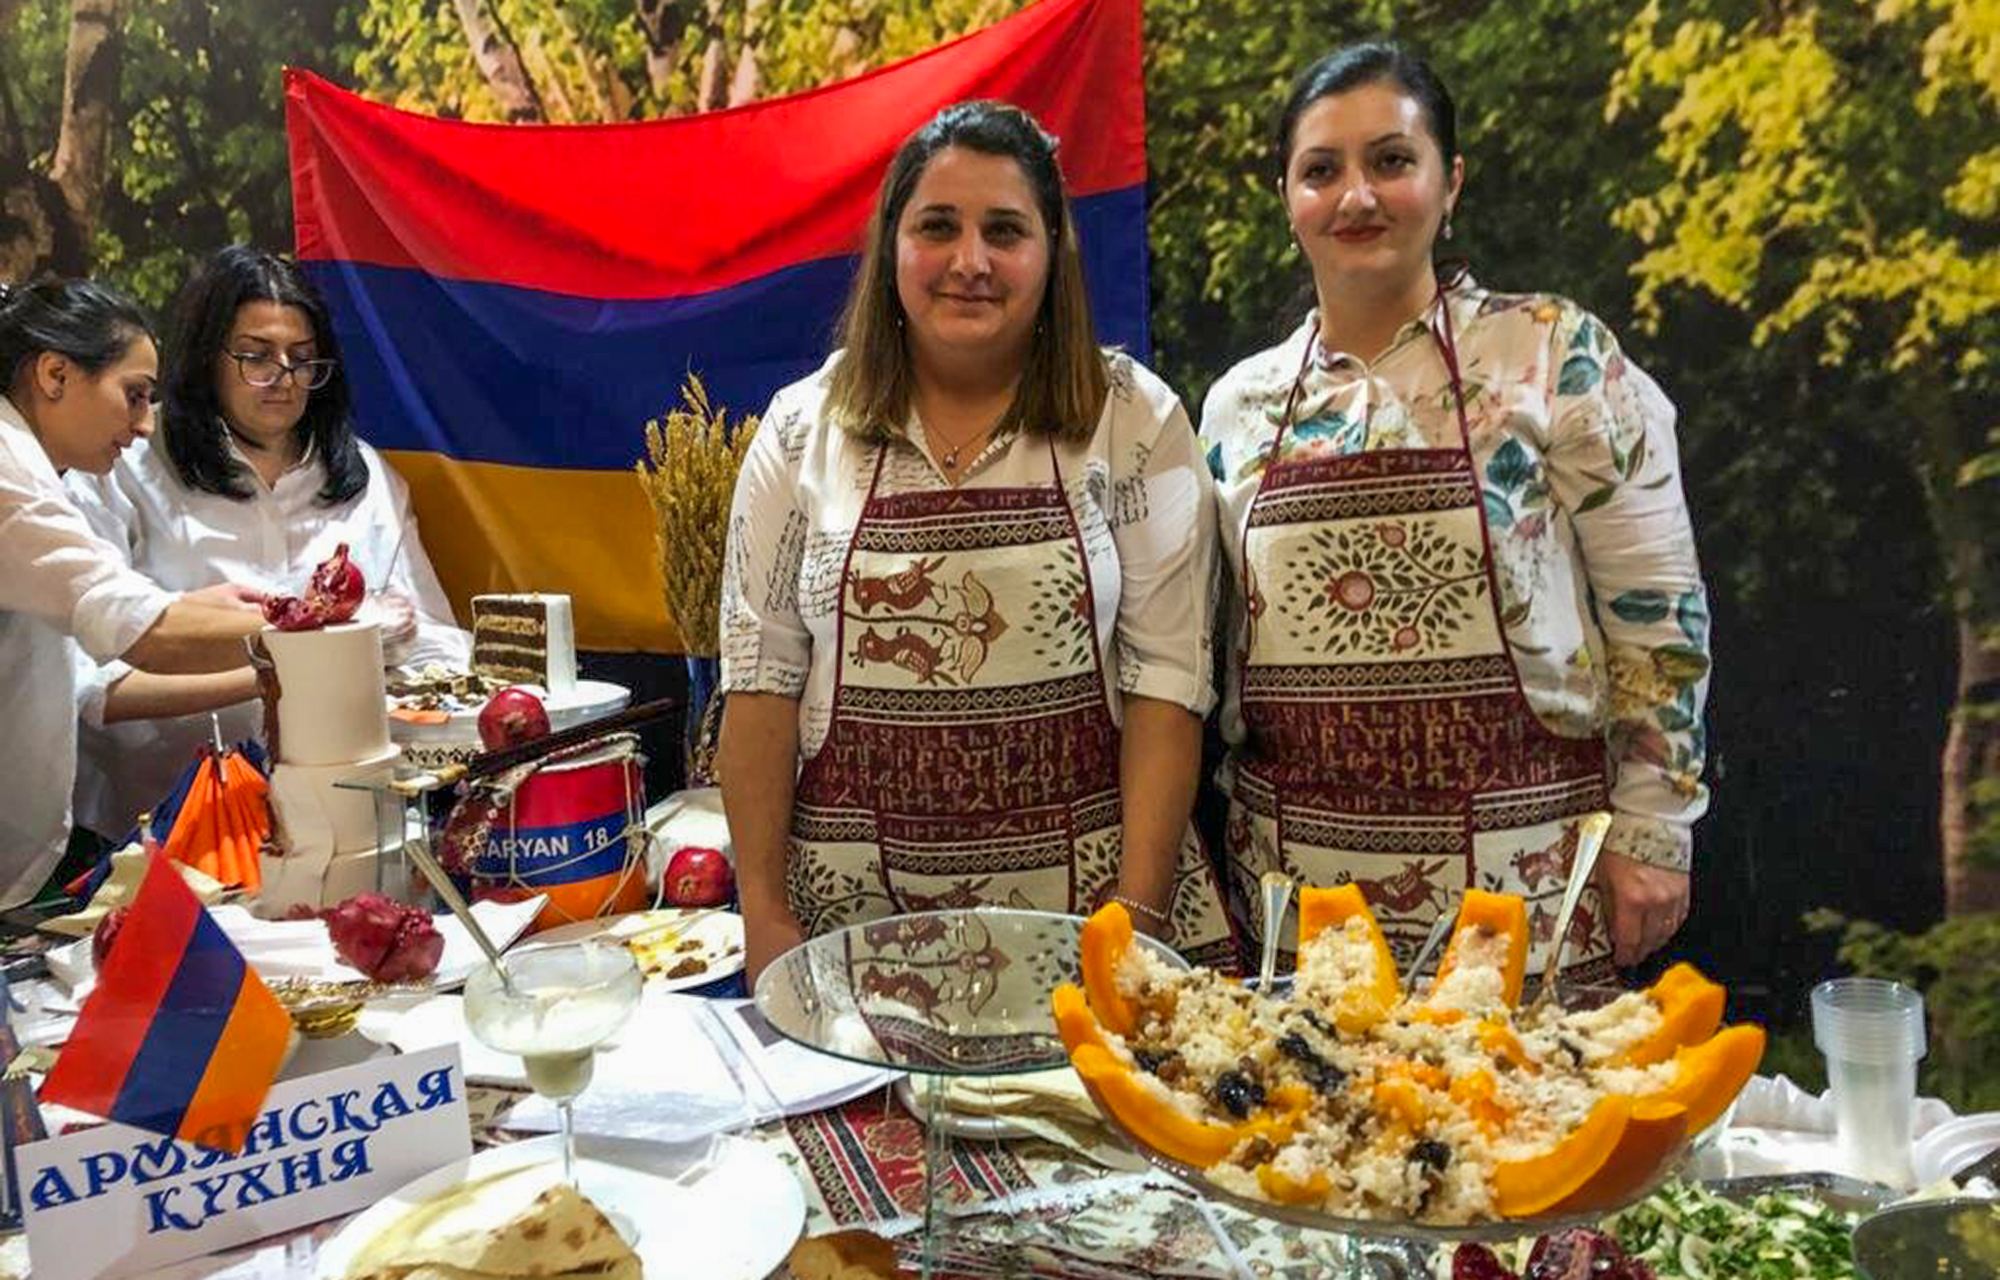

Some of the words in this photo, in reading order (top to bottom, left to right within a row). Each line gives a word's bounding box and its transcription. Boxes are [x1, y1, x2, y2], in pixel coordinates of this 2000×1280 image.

[475, 835, 570, 859] ARYAN
[583, 826, 609, 850] 18
[143, 1135, 374, 1234] КУХНЯ
